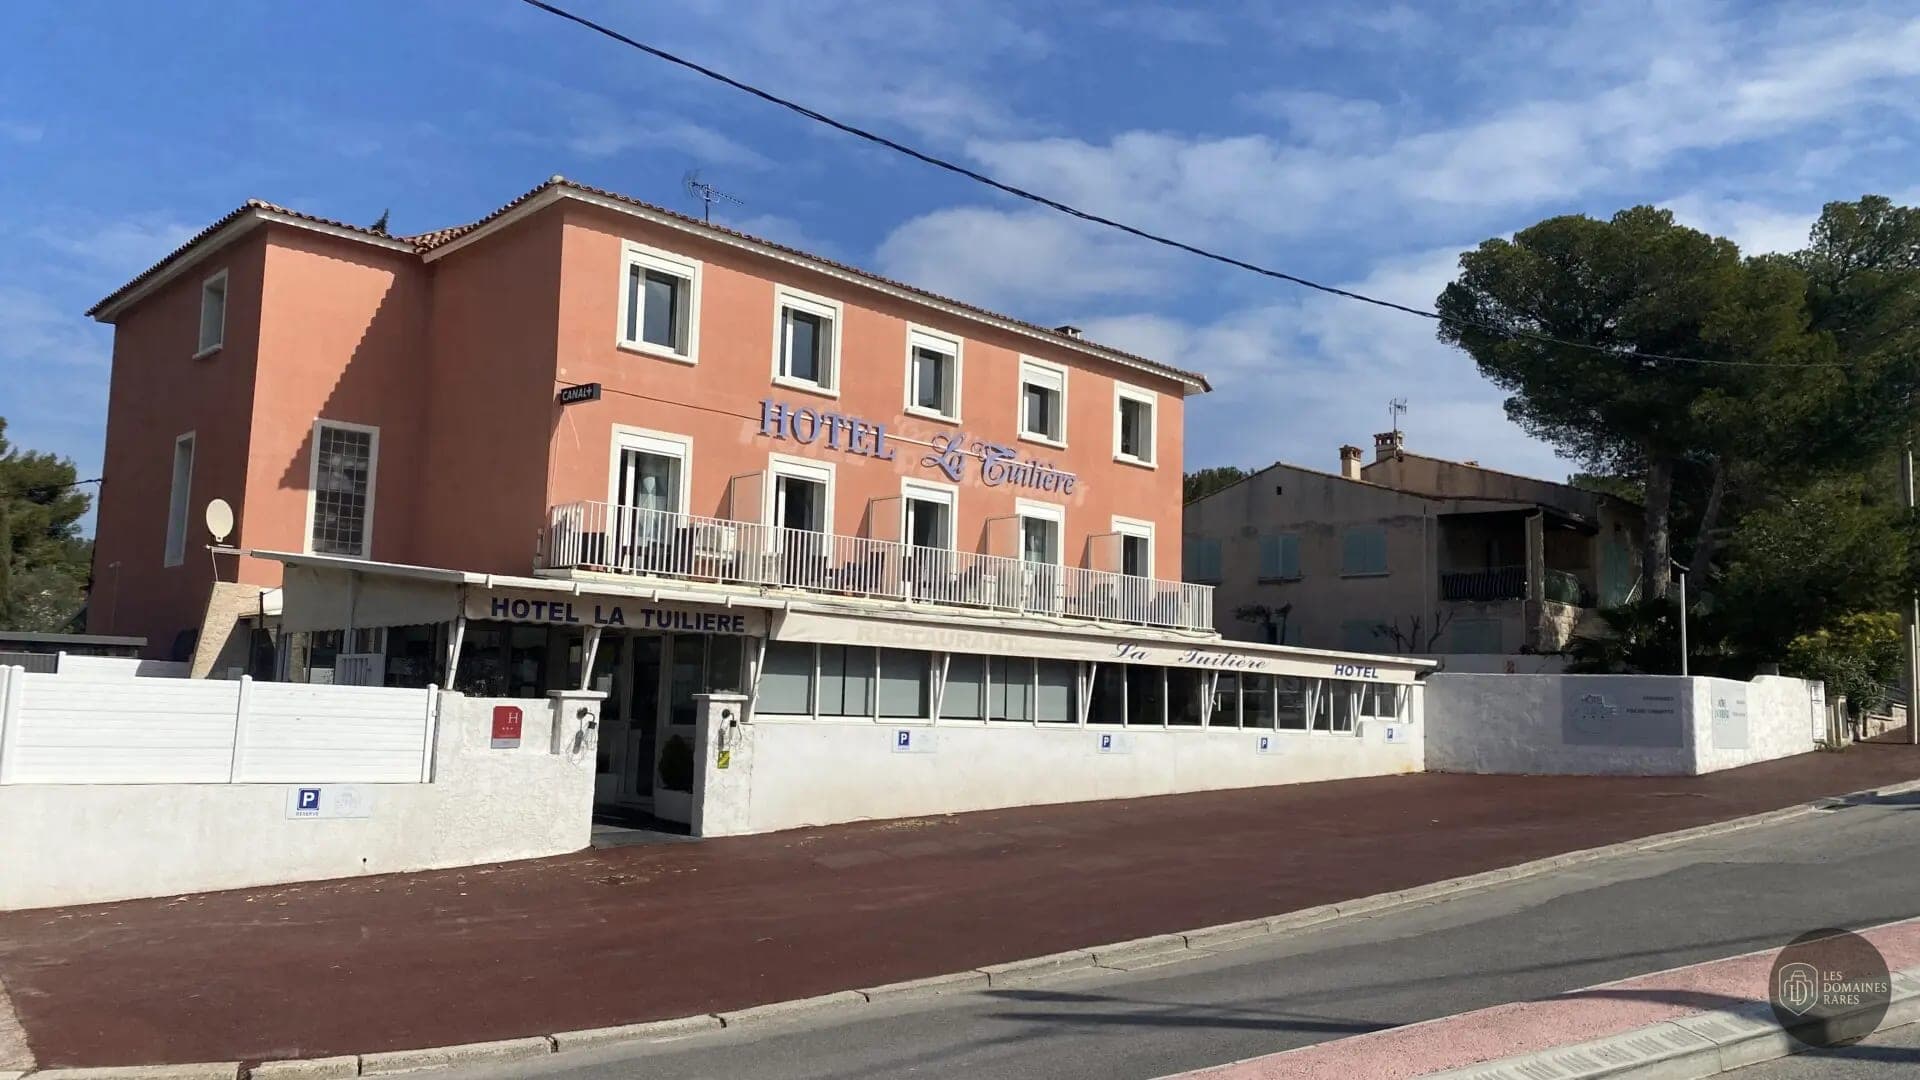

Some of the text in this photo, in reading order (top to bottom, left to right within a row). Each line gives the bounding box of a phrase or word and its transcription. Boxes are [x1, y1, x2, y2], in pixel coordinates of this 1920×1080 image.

[562, 387, 593, 401] CANAL+
[757, 397, 896, 461] HOTEL
[920, 432, 1076, 495] La Tuilière
[491, 597, 745, 633] HOTEL LA TUILIERE
[856, 624, 1017, 650] RESTAURANT
[1109, 641, 1152, 661] La
[1334, 663, 1379, 679] HOTEL
[508, 712, 518, 724] H
[302, 791, 315, 807] P
